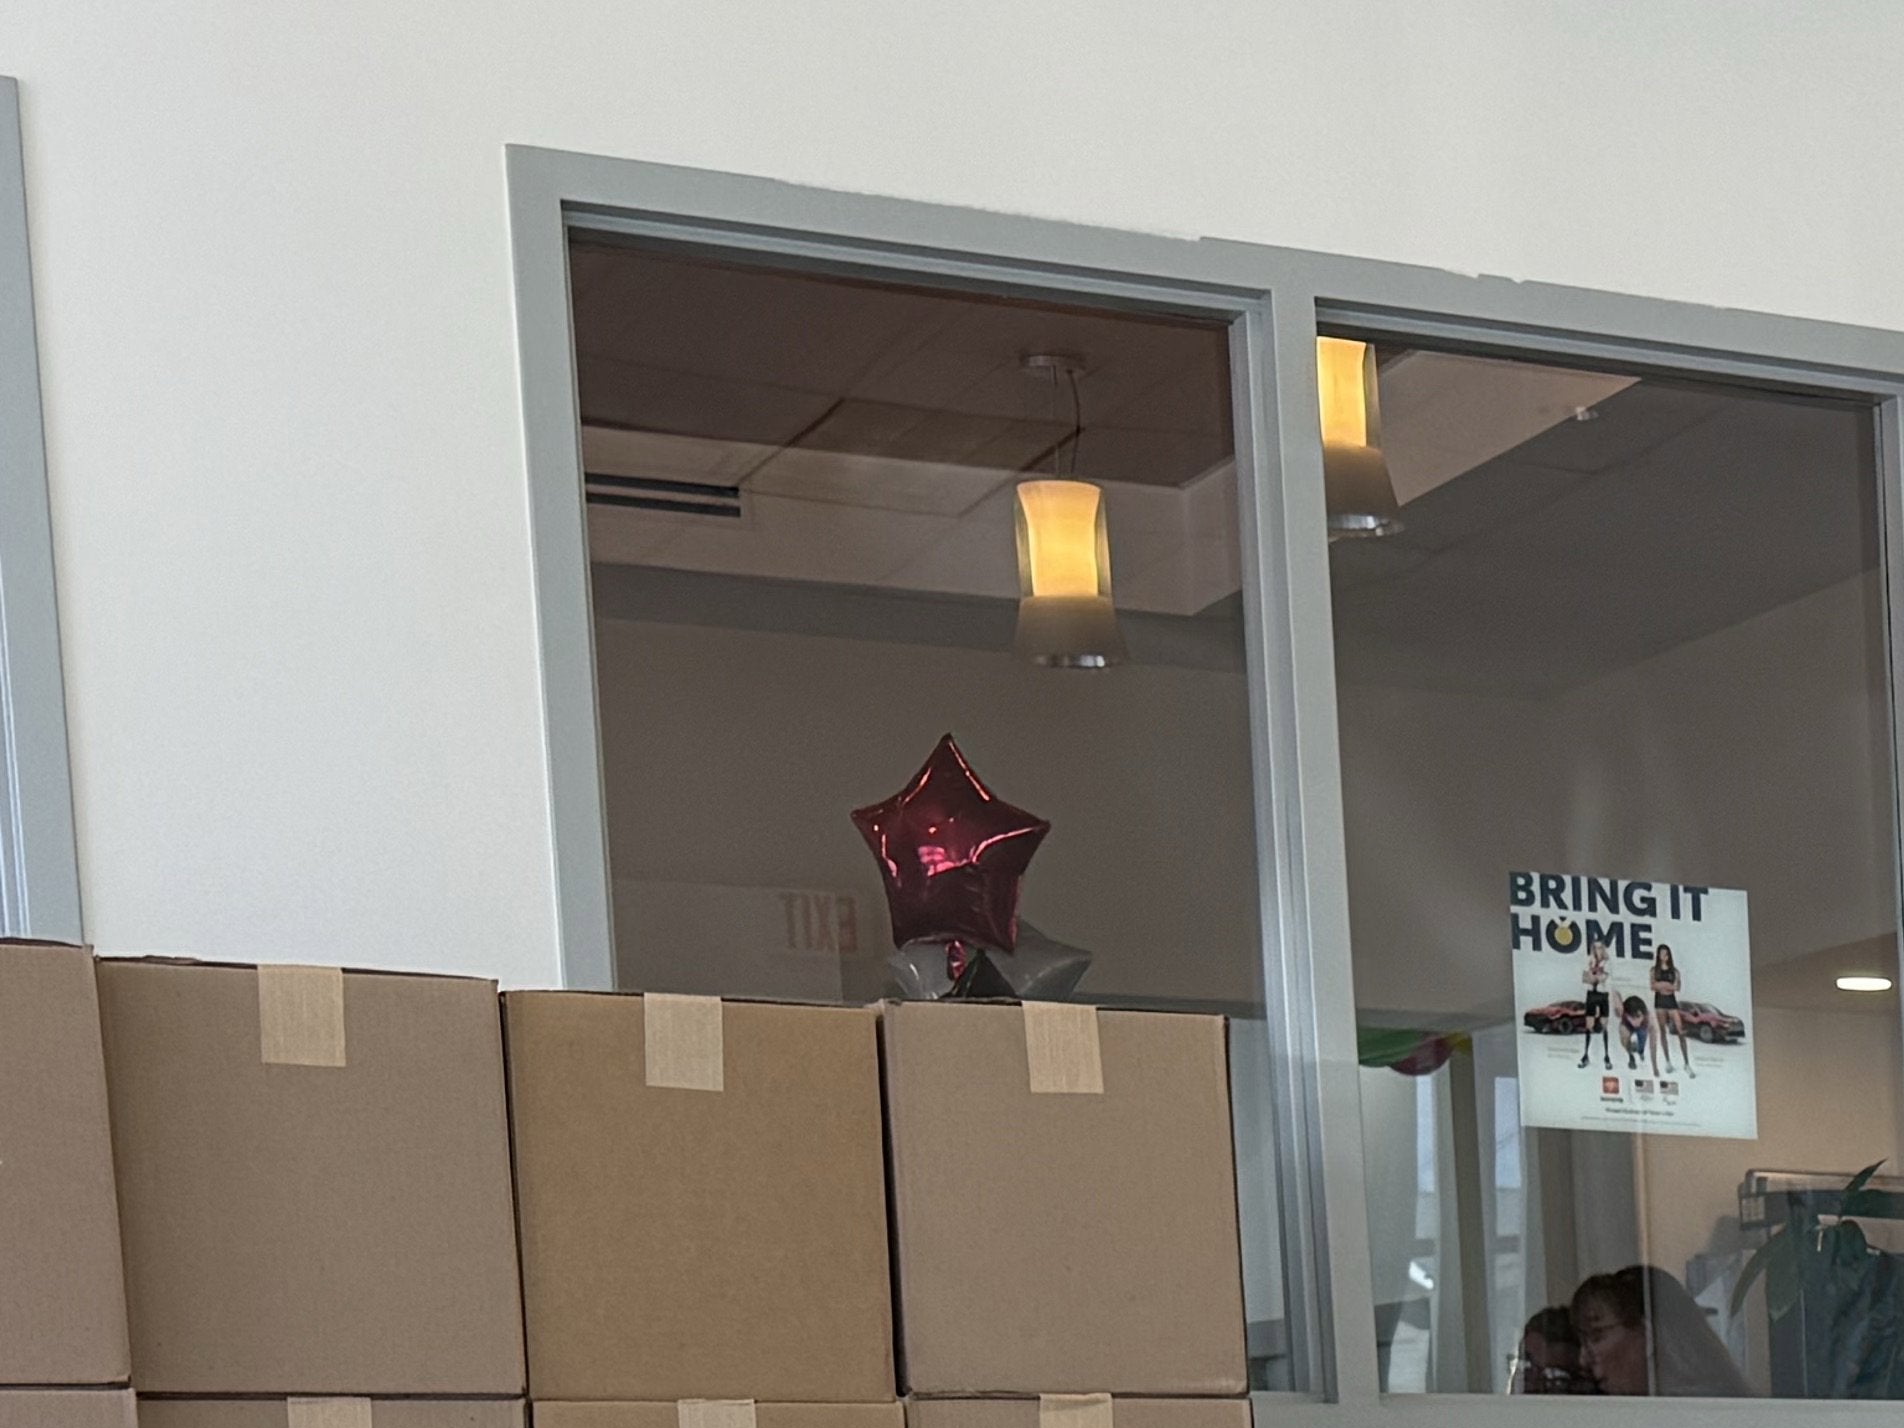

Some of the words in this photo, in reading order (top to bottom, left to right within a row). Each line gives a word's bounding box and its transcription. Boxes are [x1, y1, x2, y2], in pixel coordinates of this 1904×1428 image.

[1509, 871, 1657, 918] BRING
[1669, 884, 1709, 922] IT
[1510, 912, 1655, 961] HOME
